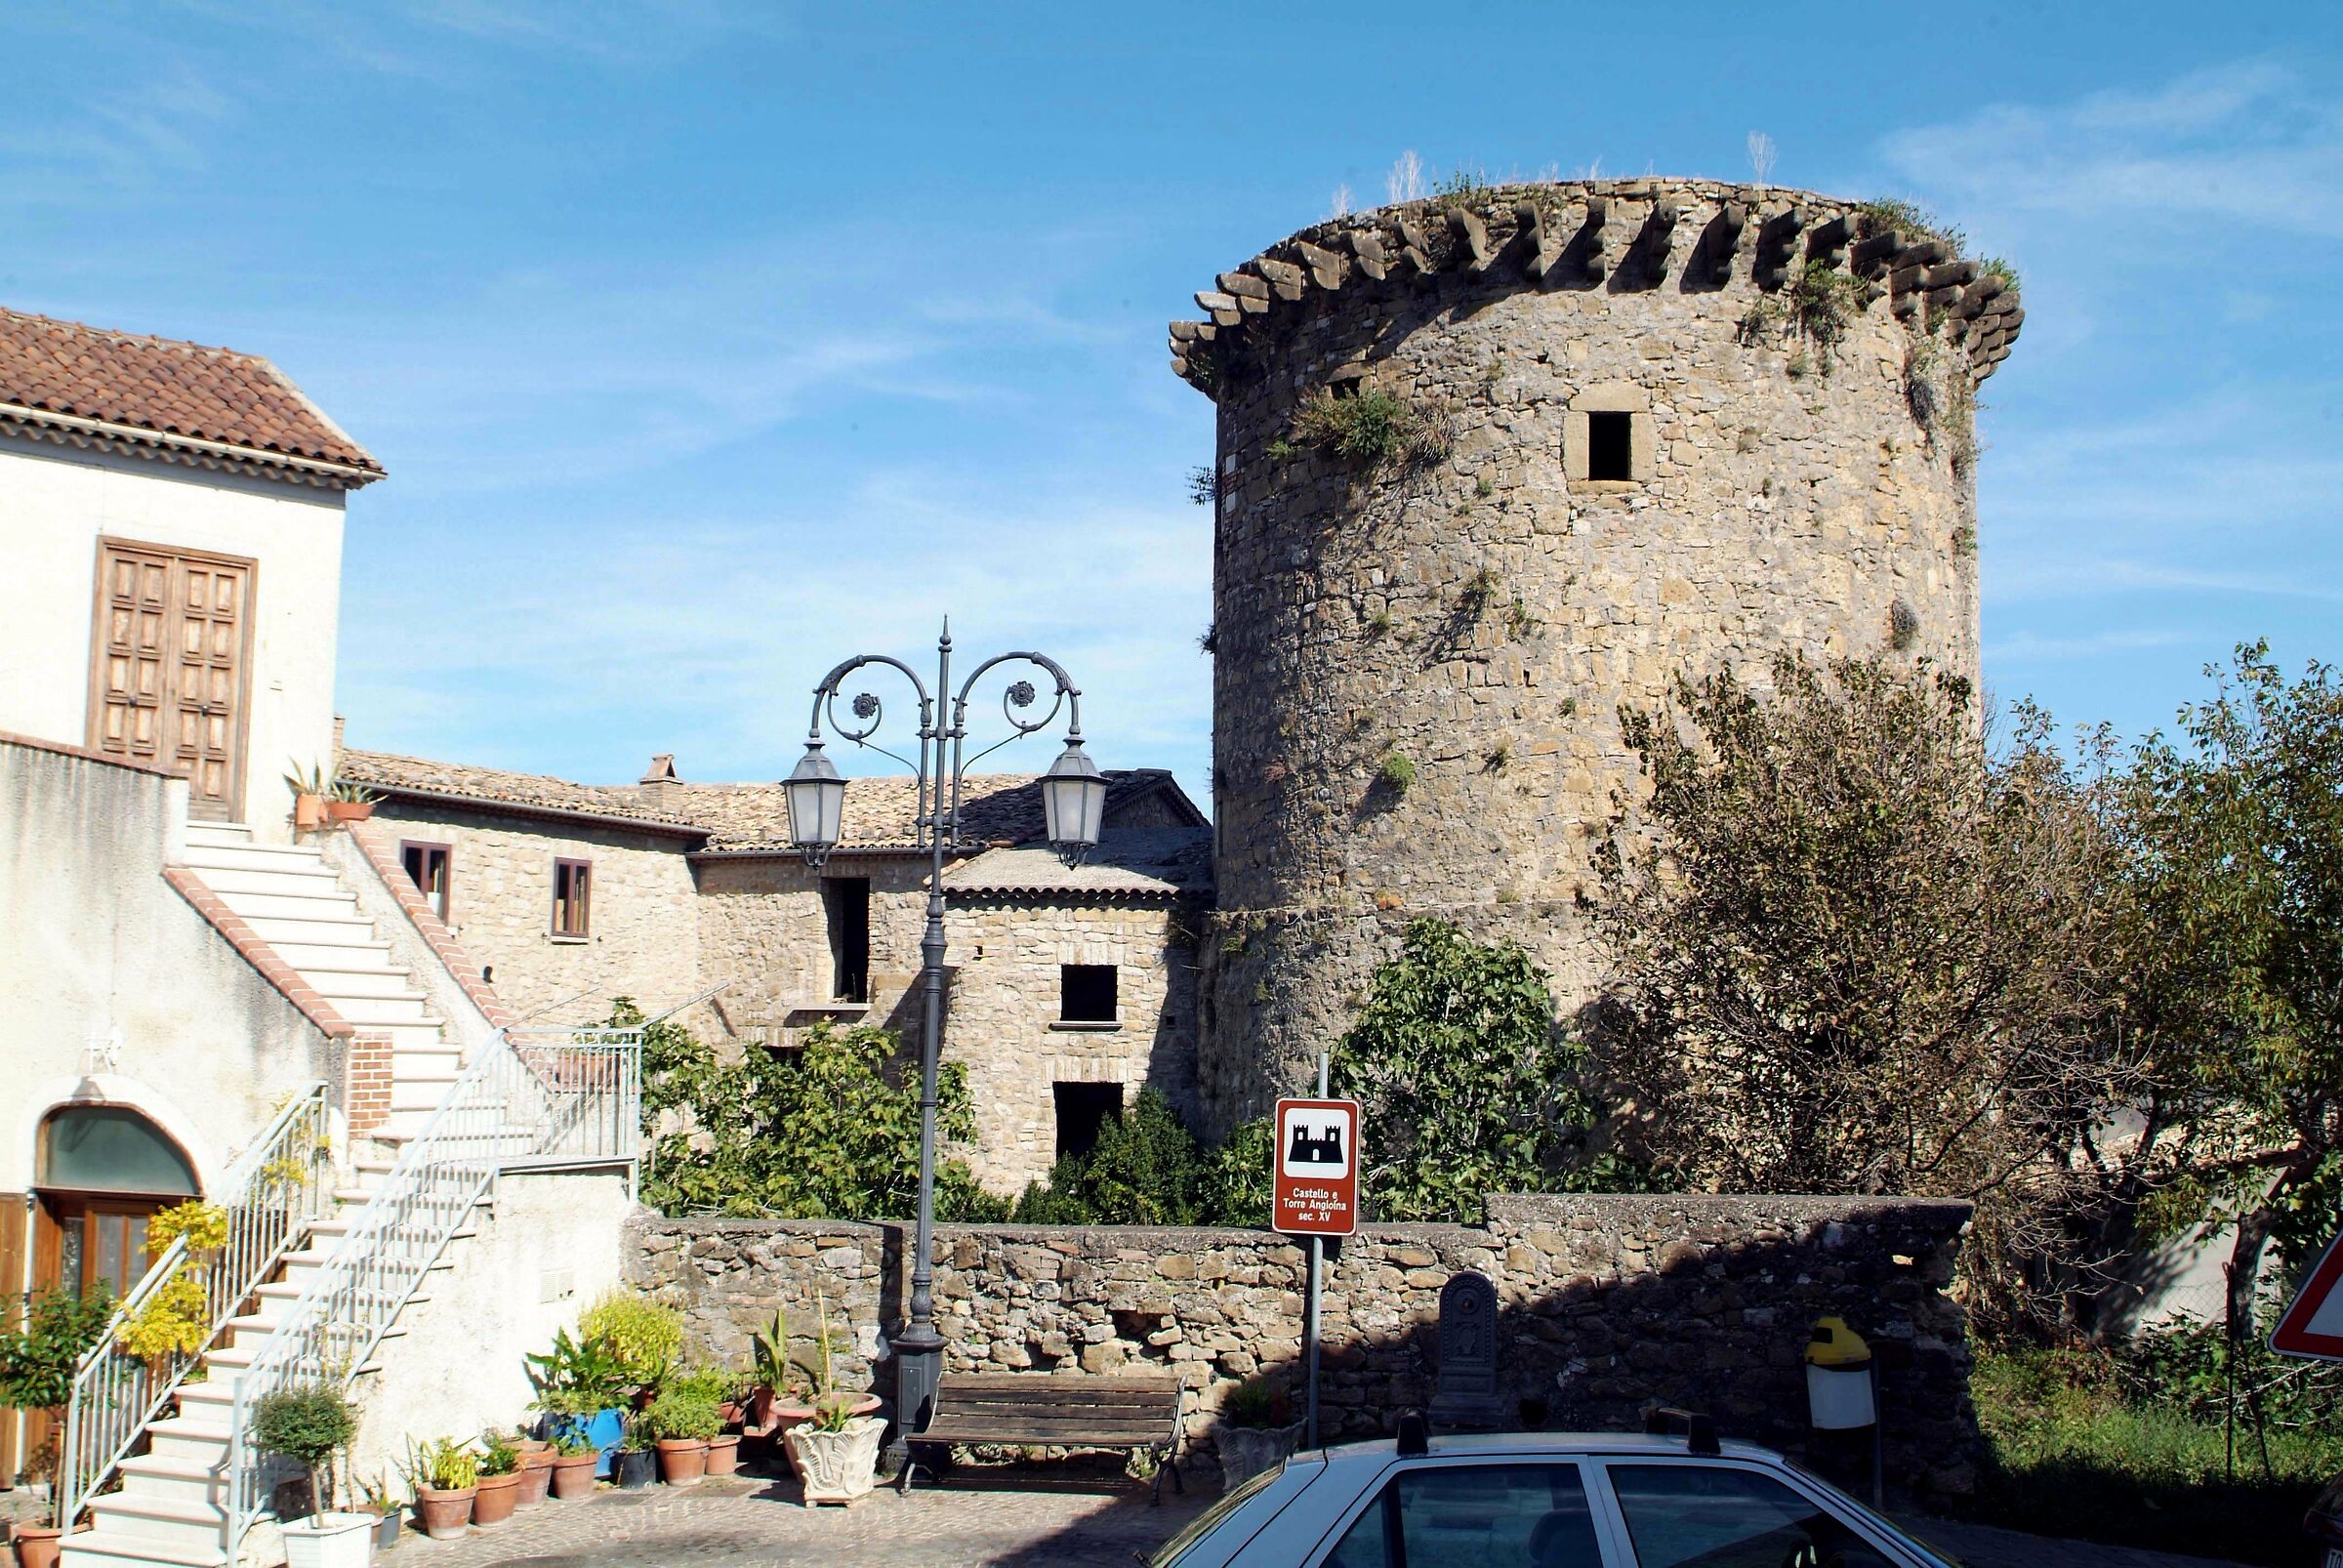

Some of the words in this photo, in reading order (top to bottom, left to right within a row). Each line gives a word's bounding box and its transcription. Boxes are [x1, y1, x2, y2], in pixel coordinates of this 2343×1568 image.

[1293, 1187, 1329, 1199] Castello
[1283, 1198, 1305, 1209] Torre
[1298, 1212, 1315, 1220] sec.
[1318, 1211, 1331, 1221] XV
